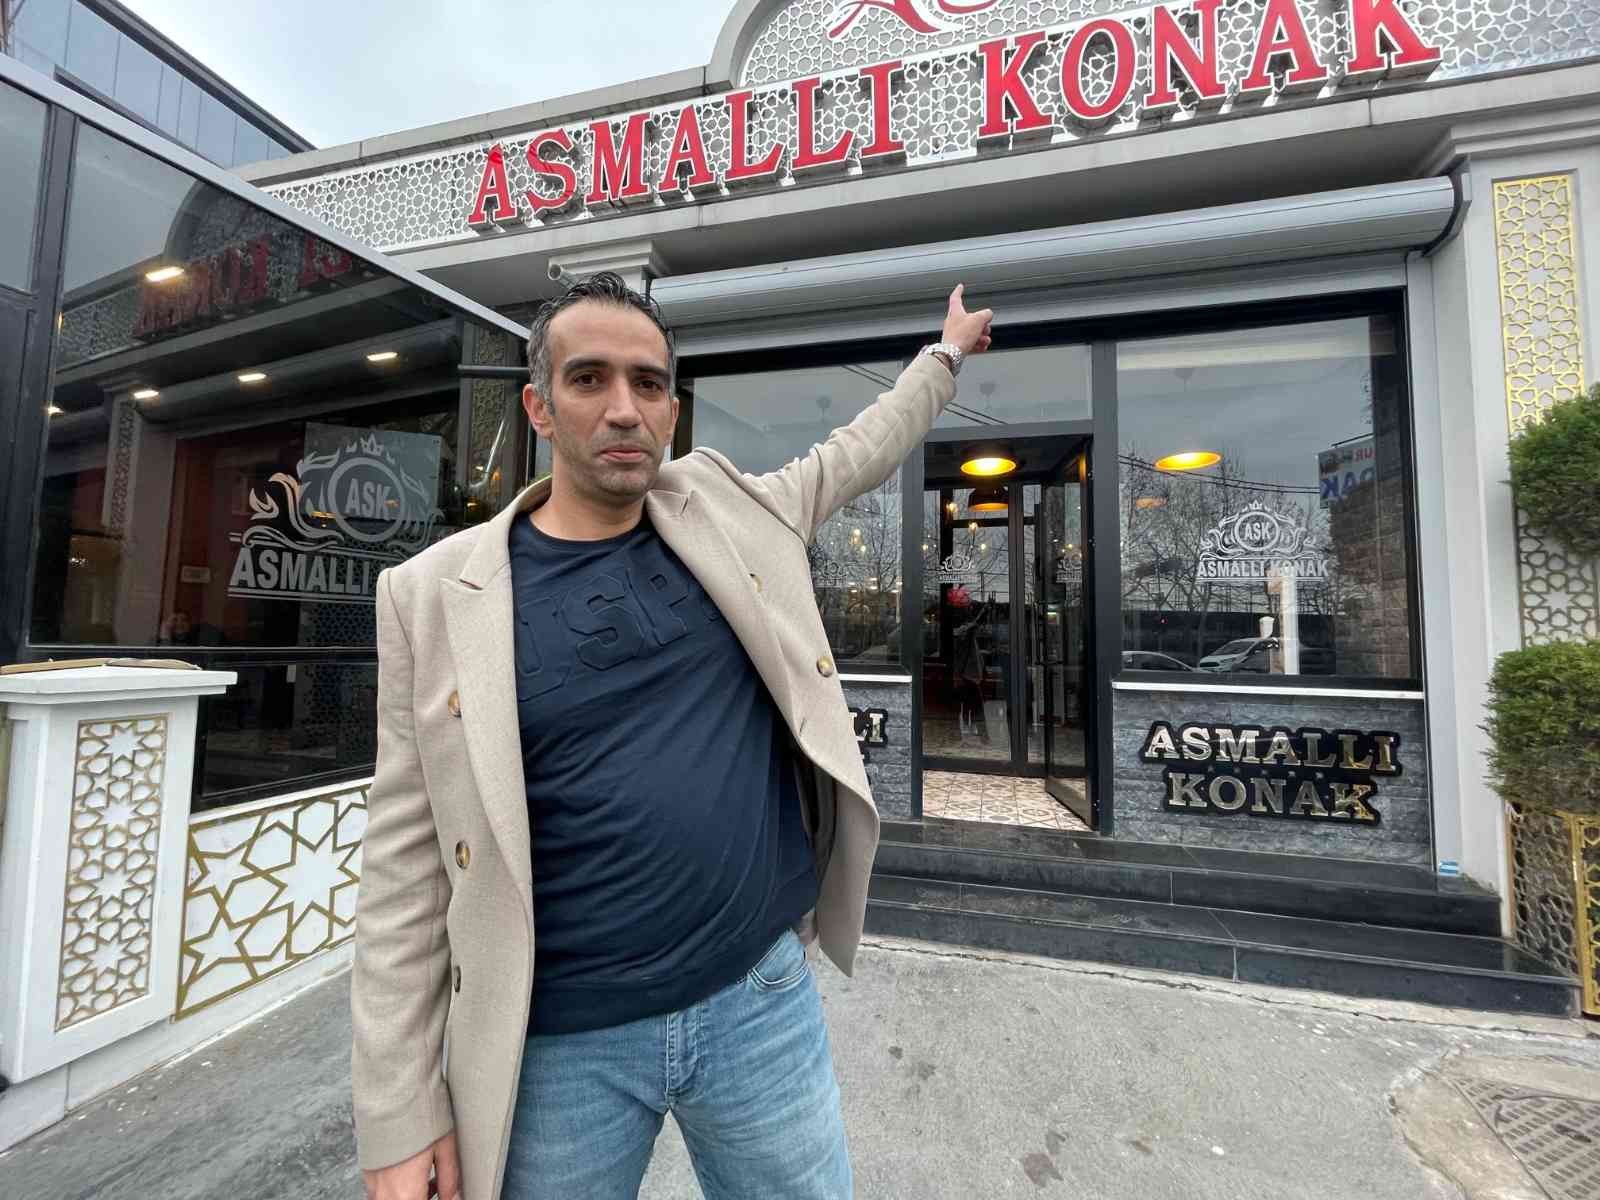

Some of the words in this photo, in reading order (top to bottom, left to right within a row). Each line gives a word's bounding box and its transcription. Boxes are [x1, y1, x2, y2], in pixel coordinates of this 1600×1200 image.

[468, 60, 907, 224] ASMALLI
[977, 0, 1441, 138] KONAK
[345, 478, 391, 521] ASK
[1244, 522, 1271, 541] ASK
[229, 547, 370, 594] ASMALLI
[1197, 559, 1265, 577] ASMALLI
[1269, 559, 1329, 577] KONAK
[1144, 725, 1396, 771] ASMALLI
[1168, 771, 1376, 821] KONAK
